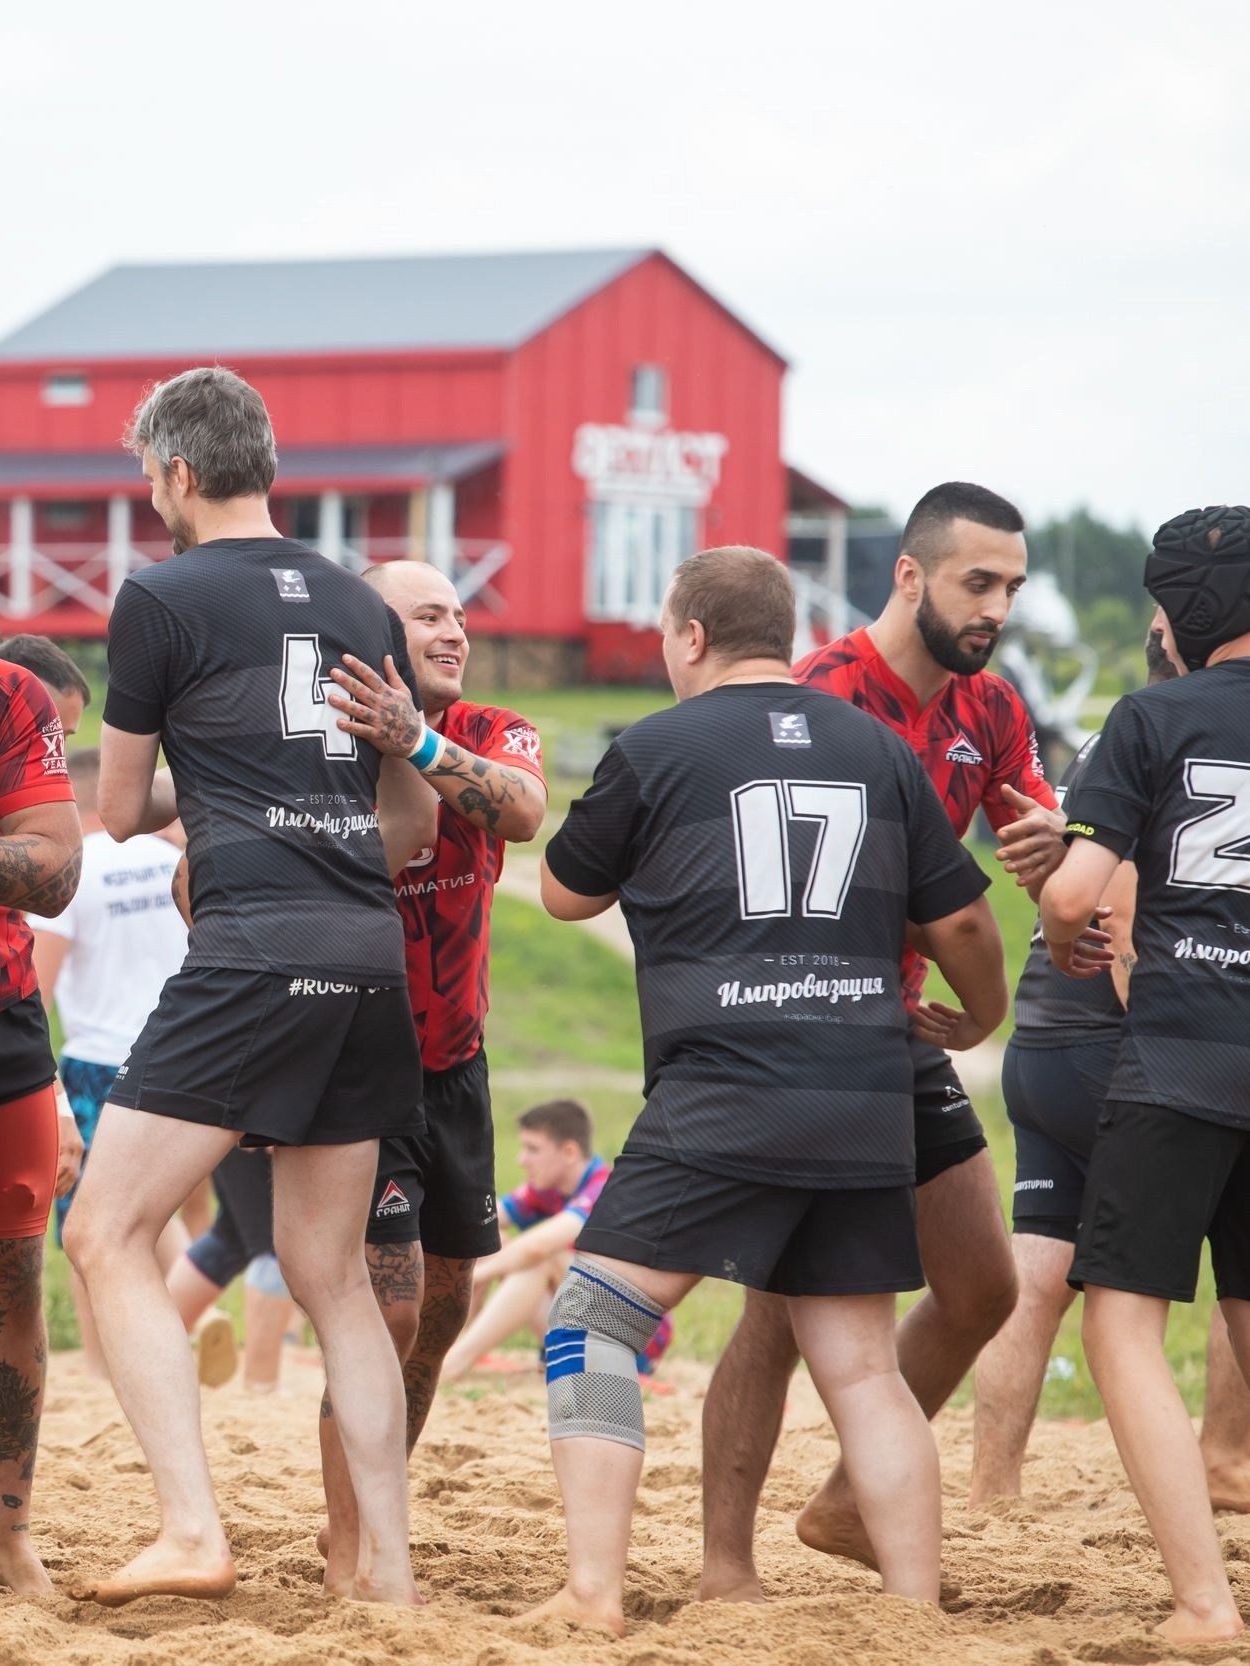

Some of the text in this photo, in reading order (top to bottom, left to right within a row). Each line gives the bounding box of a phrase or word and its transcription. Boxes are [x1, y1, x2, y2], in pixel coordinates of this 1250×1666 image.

[278, 633, 358, 762] 4
[729, 779, 868, 920] 17
[1166, 758, 1250, 894] 2
[716, 973, 885, 1008] Импровизация
[813, 954, 840, 967] 2018
